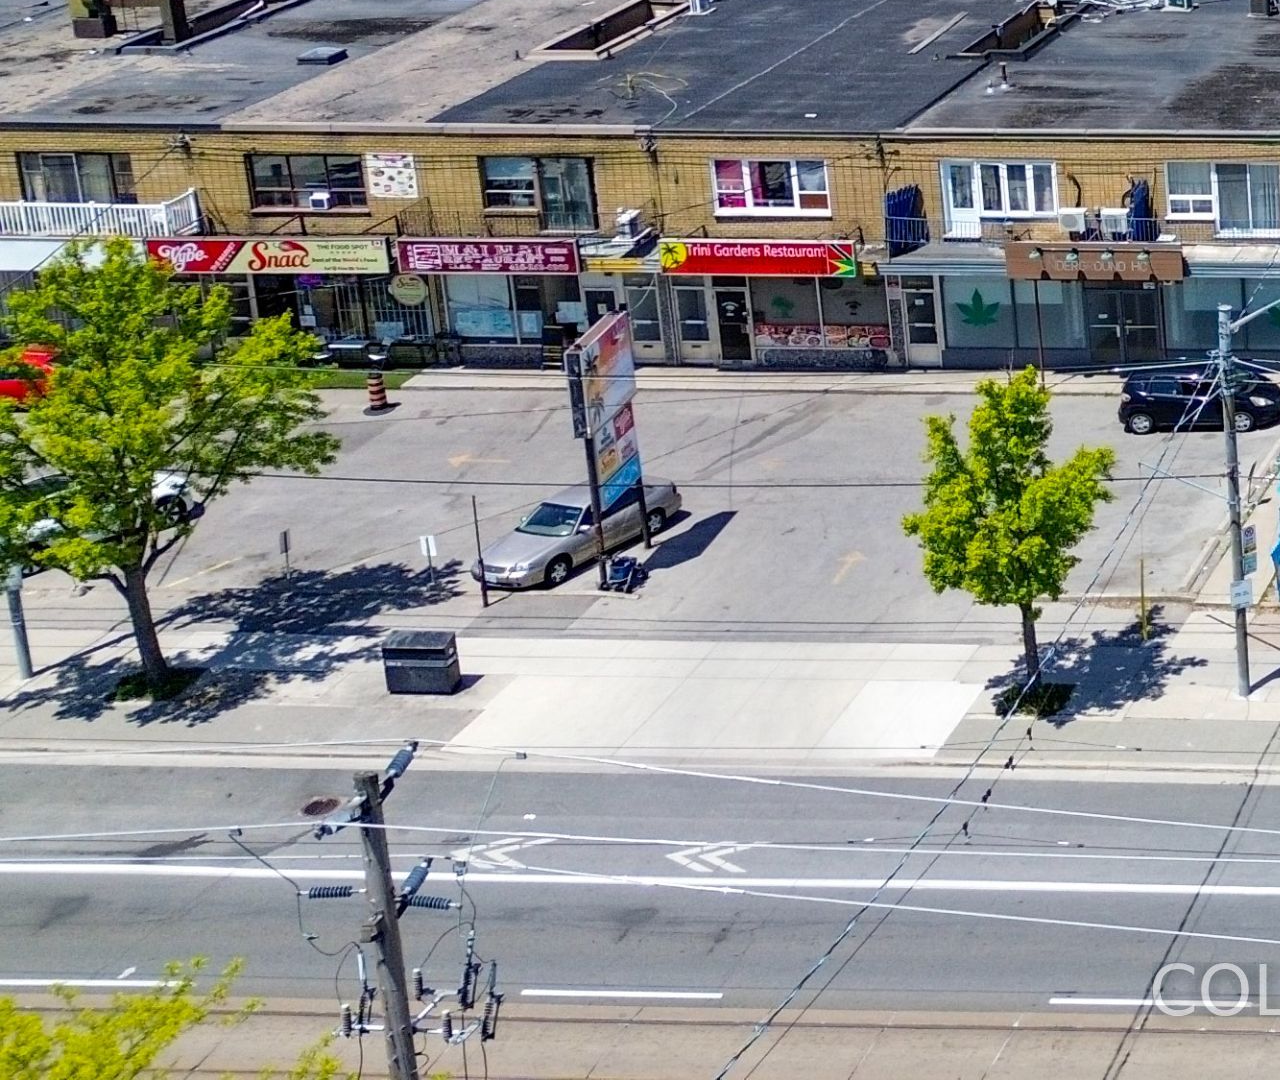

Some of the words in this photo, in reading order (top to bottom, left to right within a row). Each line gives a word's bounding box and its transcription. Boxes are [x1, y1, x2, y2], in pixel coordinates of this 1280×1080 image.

[248, 240, 311, 271] Snacc
[686, 244, 711, 256] Trini
[713, 244, 761, 257] Gardens
[763, 245, 827, 258] Restaurant
